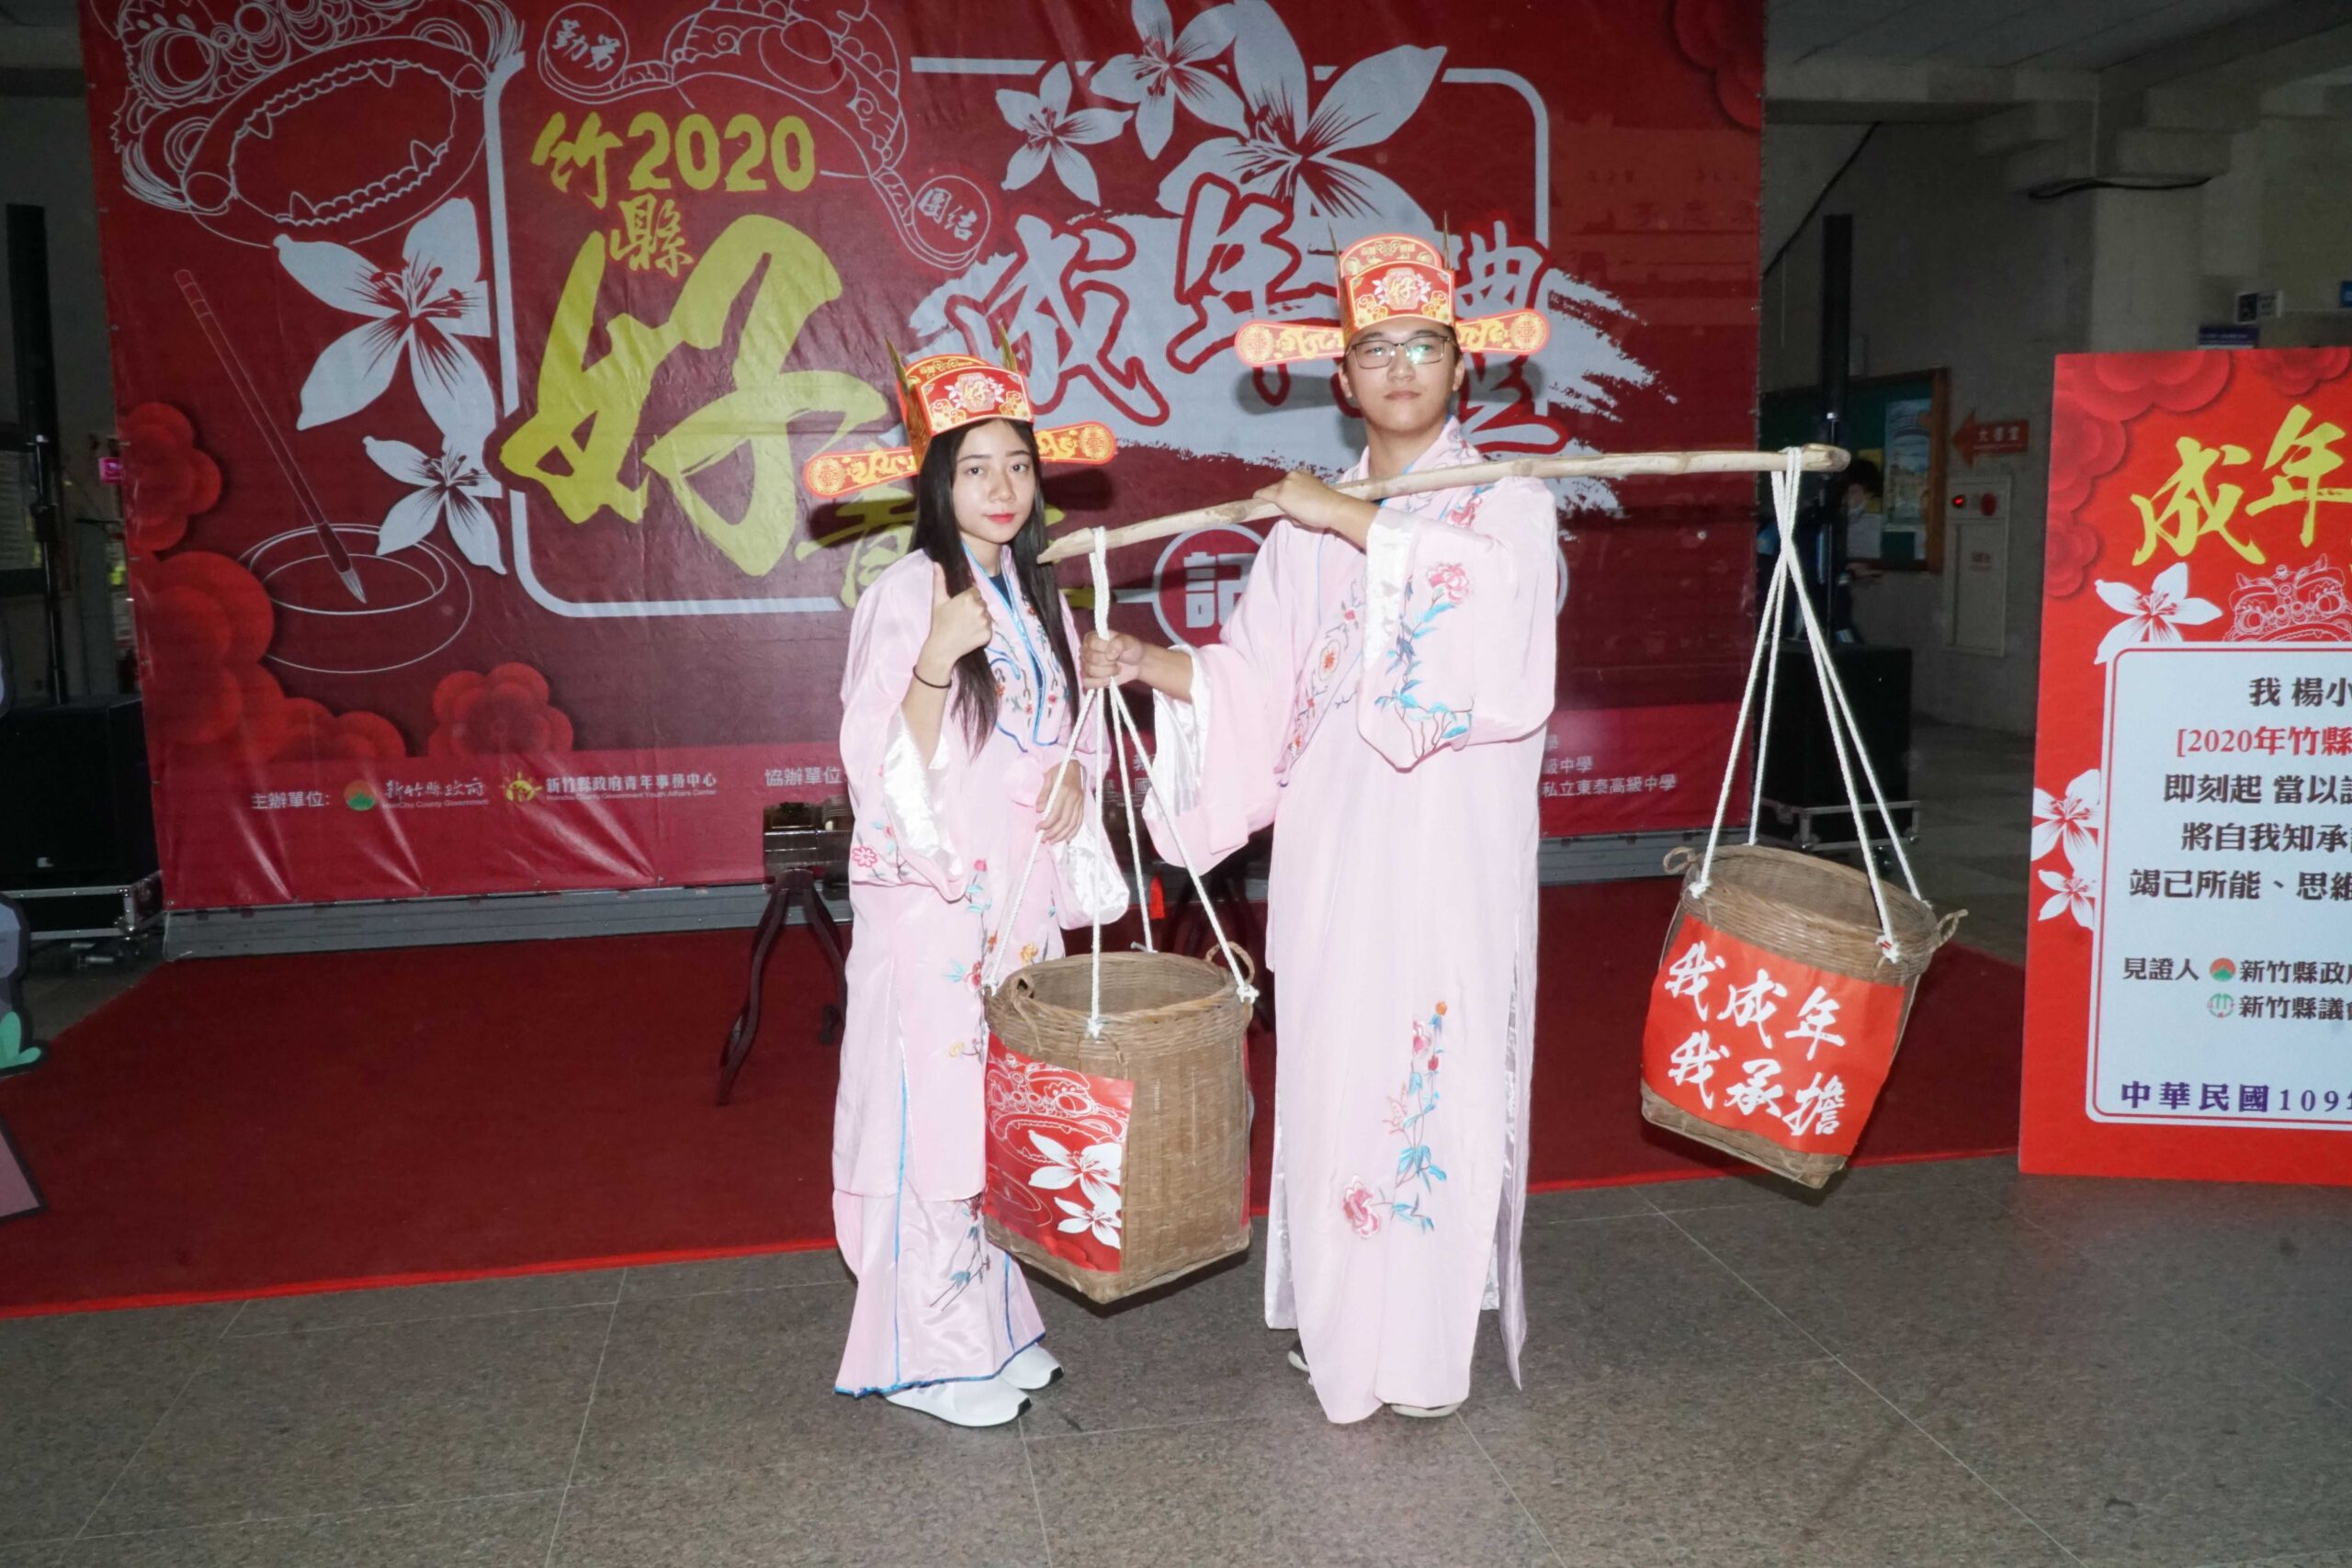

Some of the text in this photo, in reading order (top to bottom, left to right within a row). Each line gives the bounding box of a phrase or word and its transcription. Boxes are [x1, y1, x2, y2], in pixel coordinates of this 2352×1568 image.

[628, 111, 817, 192] 2020
[499, 213, 888, 577] 好
[2131, 404, 2352, 566] 成年
[2249, 677, 2281, 706] 我
[2164, 773, 2262, 805] 即刻起
[2181, 822, 2352, 852] 將自我知承
[2122, 956, 2199, 981] 見證人
[2240, 959, 2352, 985] 新竹縣政
[1665, 941, 1846, 1060] 我成年
[1668, 1030, 1846, 1136] 我承擔
[2121, 1080, 2352, 1113] 中華民國109
